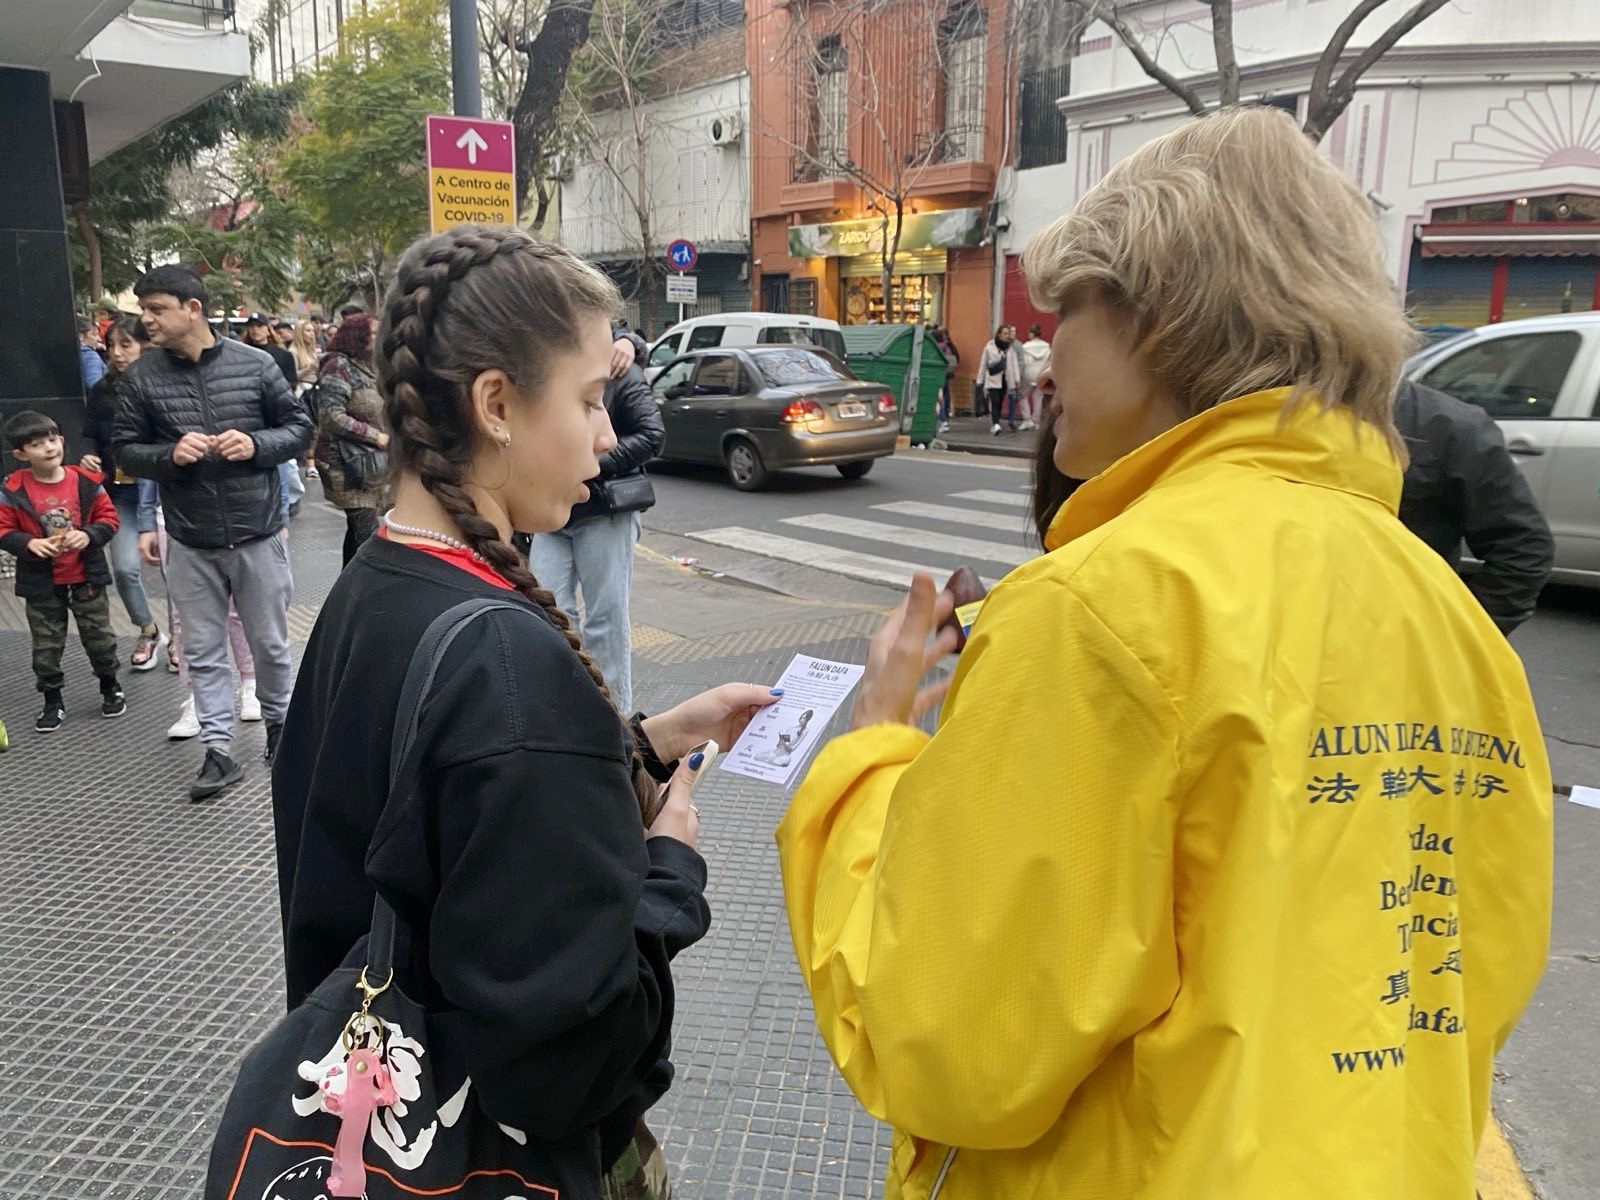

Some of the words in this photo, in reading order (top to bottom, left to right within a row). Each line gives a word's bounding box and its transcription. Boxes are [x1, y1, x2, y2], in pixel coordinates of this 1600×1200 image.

[436, 175, 445, 187] A
[449, 176, 491, 190] Centro
[495, 179, 510, 191] de
[437, 192, 509, 207] Vacunación
[444, 210, 504, 223] COVID-19
[809, 661, 831, 672] FALUN
[830, 665, 849, 675] DAFA
[1308, 723, 1390, 758] ALUN
